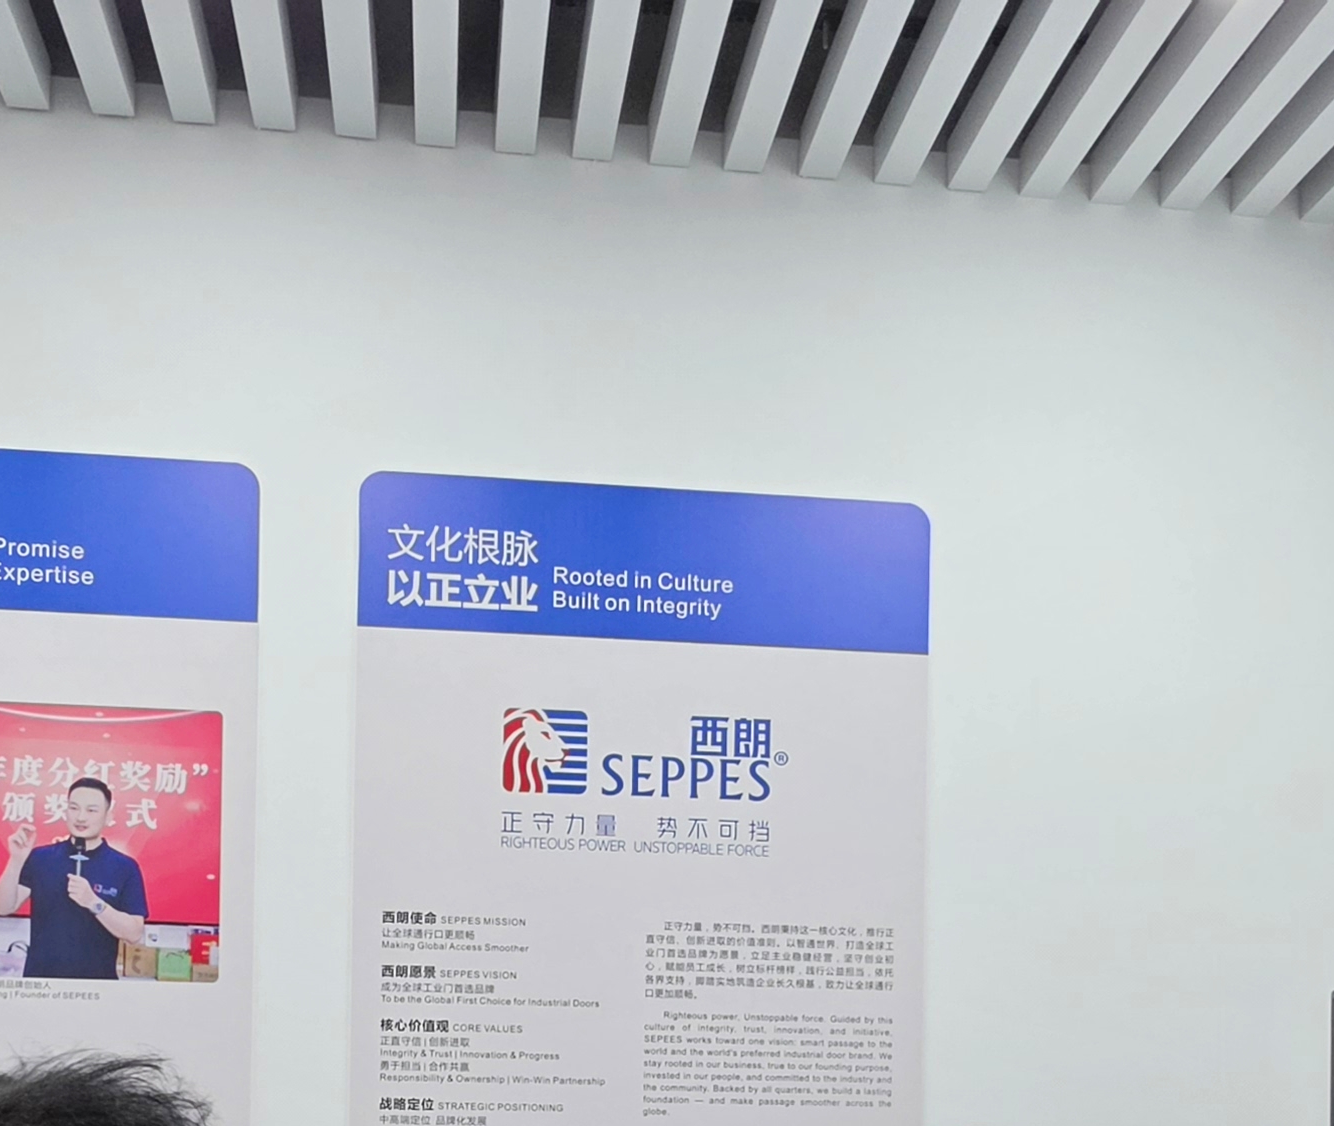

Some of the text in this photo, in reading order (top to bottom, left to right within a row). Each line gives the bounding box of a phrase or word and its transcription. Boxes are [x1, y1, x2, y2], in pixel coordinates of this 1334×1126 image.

[388, 525, 538, 565] 文化根脉
[553, 566, 733, 592] Rooted in Culture
[387, 570, 537, 610] 以正立业
[553, 590, 721, 619] Built on Integrity
[690, 716, 771, 758] 西朗
[601, 754, 771, 802] SEPPES
[2, 792, 158, 830] 颁奖式
[501, 811, 769, 841] 正守力量 势不可挡
[501, 836, 769, 857] RIGHTEOUS POWER UNSTOPPABLE FORCE
[382, 911, 525, 925] 西朗使命 SEPPES MISSION
[381, 928, 474, 939] 让全球通行口更顺畅
[381, 940, 528, 952] Making Global Access Smoother
[381, 965, 516, 979] 西朗愿景 SEPPES VISION
[380, 982, 494, 993] 成为全球工业门首选品牌
[14, 990, 50, 998] Founder
[51, 991, 60, 999] of
[62, 992, 99, 1000] SEPEES
[381, 994, 391, 1002] To
[407, 995, 421, 1003] the
[424, 995, 454, 1004] Global
[456, 996, 477, 1004] First
[479, 996, 511, 1005] Choice
[513, 997, 525, 1005] for
[528, 998, 570, 1006] Industrial
[572, 999, 599, 1007] Doors
[663, 1011, 707, 1020] Righteous
[744, 1013, 798, 1022] Unstoppable
[830, 1015, 860, 1023] Guided
[864, 1016, 874, 1025] by
[380, 1019, 448, 1032] 核心价值观
[380, 1035, 469, 1047] 正直守信 创新进取
[380, 1048, 418, 1058] Integrity
[420, 1049, 426, 1057] &
[429, 1049, 452, 1057] Trust
[509, 1051, 516, 1059] &
[518, 1051, 559, 1061] Progress
[379, 1097, 564, 1112] 战略定位 STRATEGIC POSITIONING
[379, 1115, 486, 1125] 中高端定位 品牌化发展
